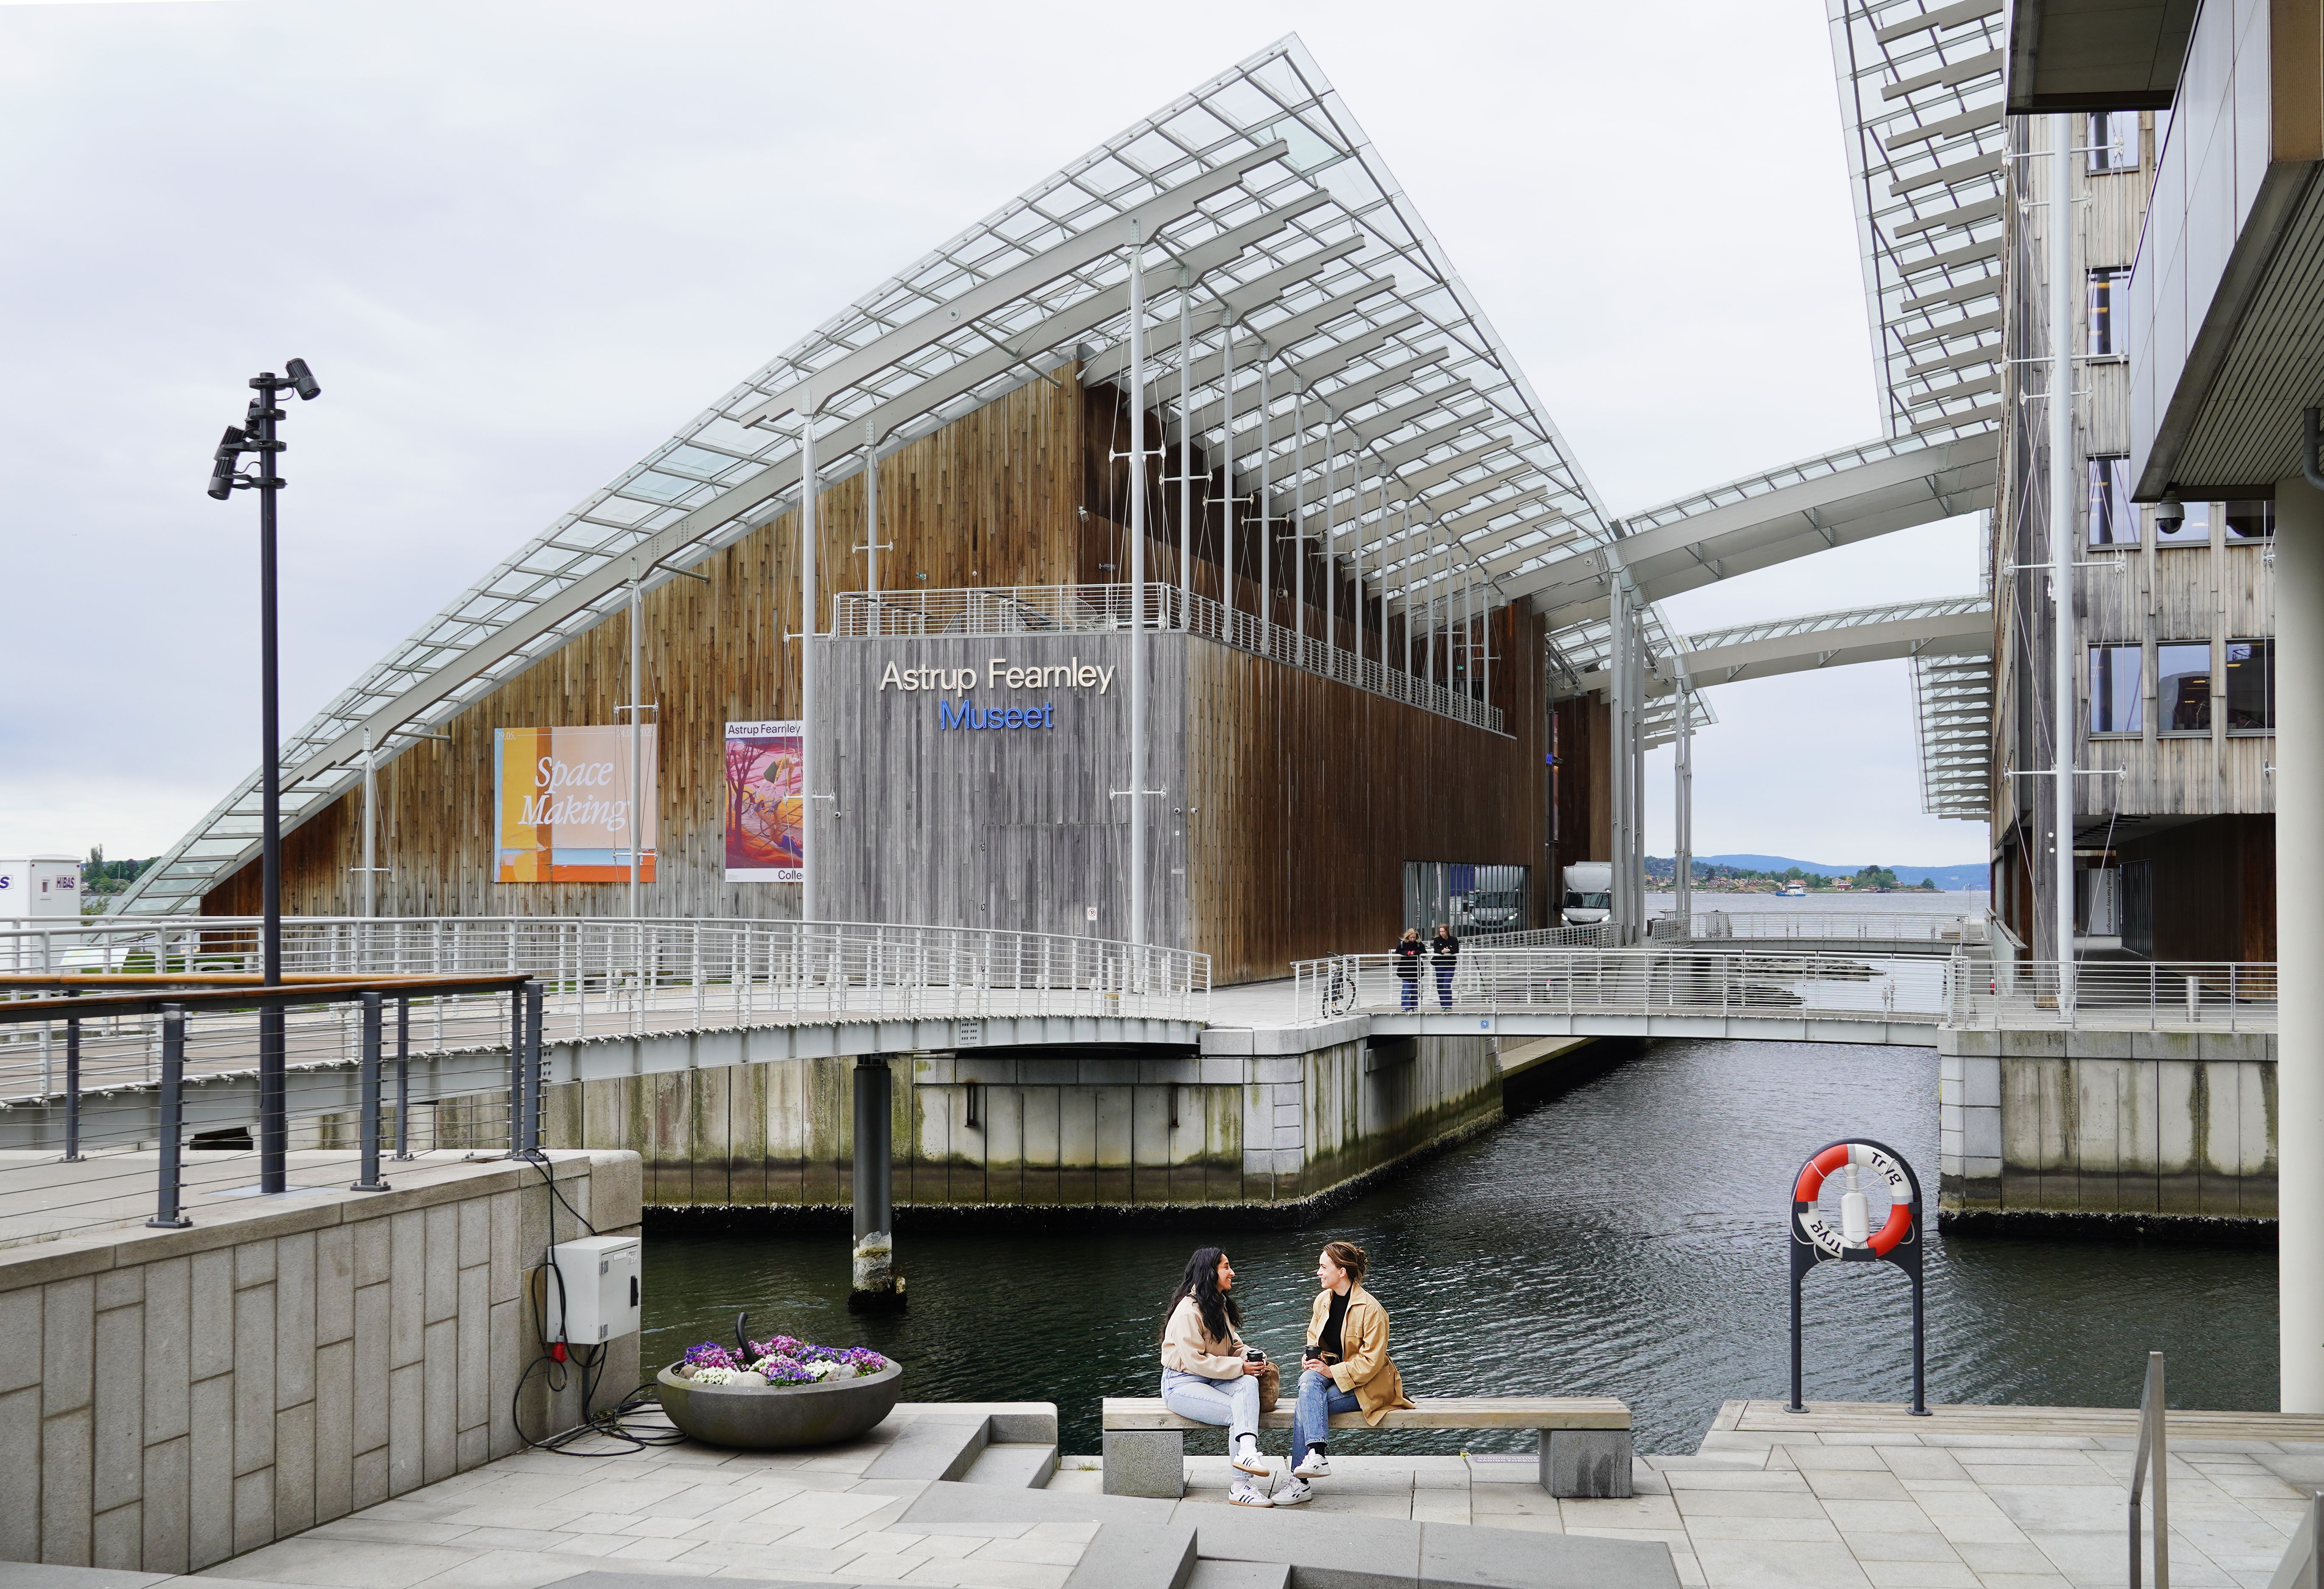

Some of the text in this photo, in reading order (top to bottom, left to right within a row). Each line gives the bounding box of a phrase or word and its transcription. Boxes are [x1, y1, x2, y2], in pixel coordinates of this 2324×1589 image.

[880, 657, 1115, 697] Astrup Fearnley
[728, 724, 801, 736] Astrup Fearnley
[941, 700, 1054, 730] Museet
[497, 731, 516, 740] 29.05.
[535, 757, 614, 794] Space
[518, 794, 631, 831] Making
[778, 870, 803, 880] Colle
[1871, 1151, 1902, 1185] Tryg
[1810, 1220, 1841, 1254] Tryg
